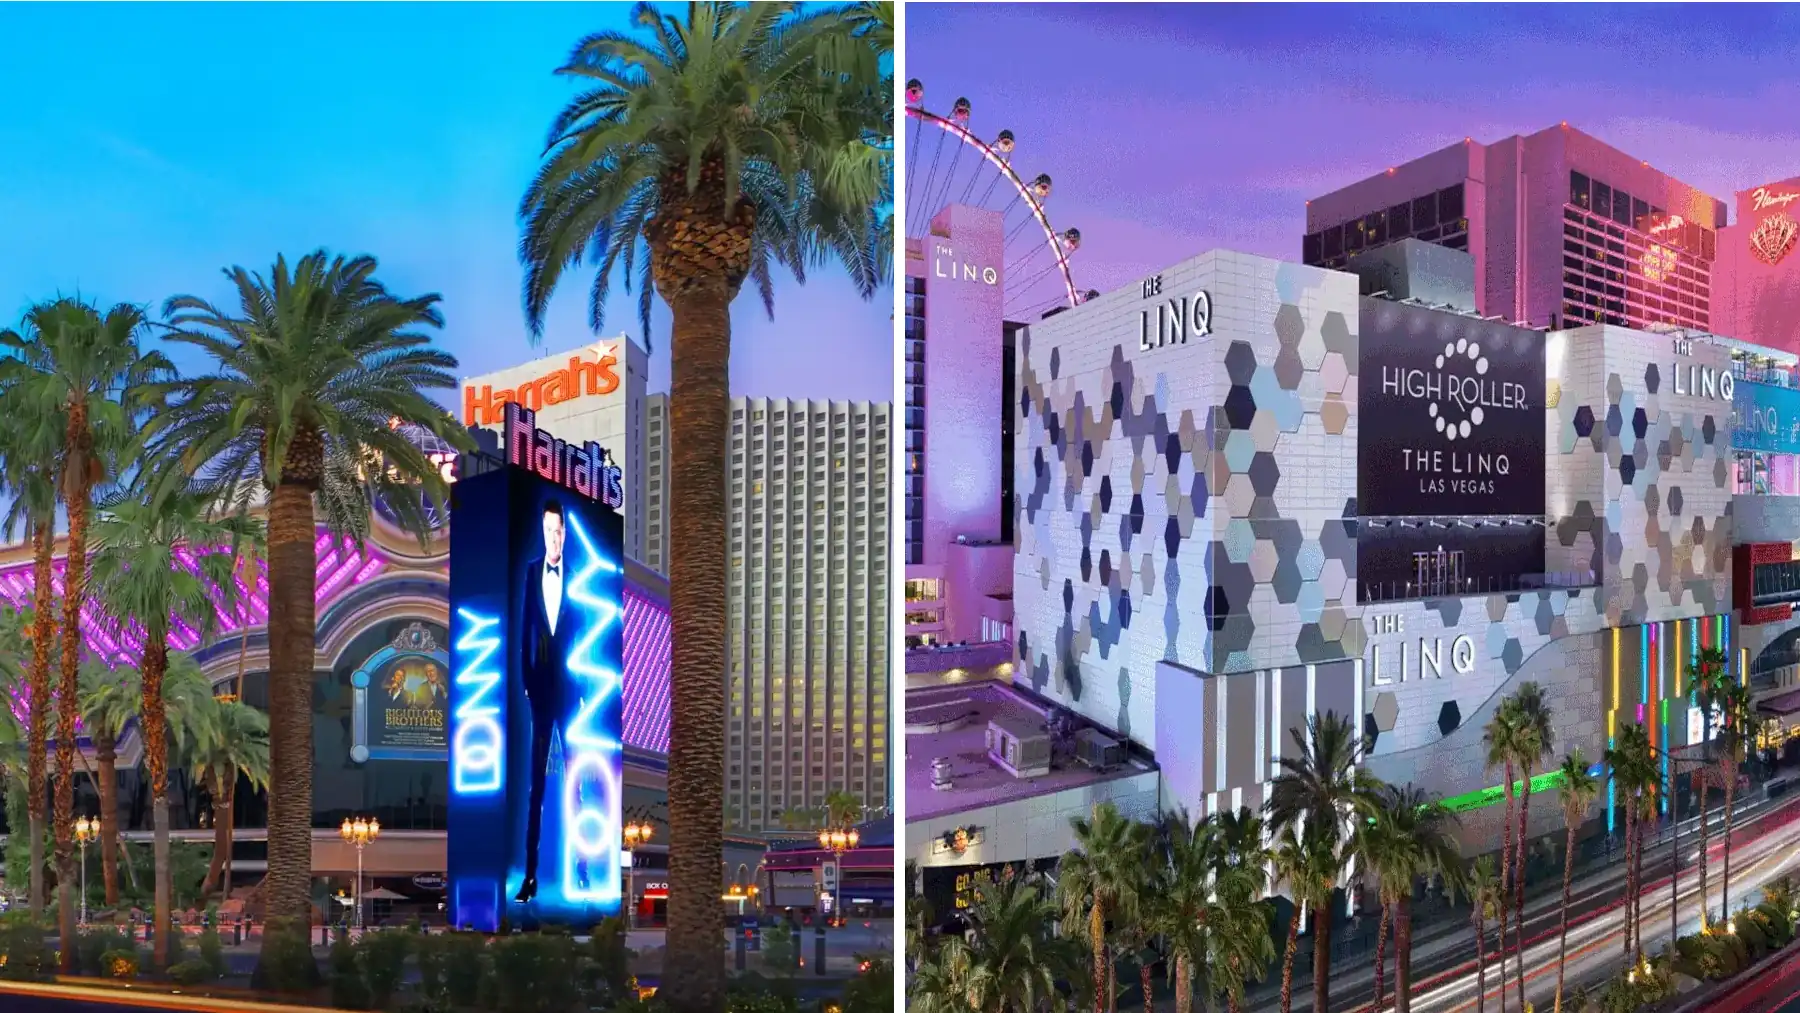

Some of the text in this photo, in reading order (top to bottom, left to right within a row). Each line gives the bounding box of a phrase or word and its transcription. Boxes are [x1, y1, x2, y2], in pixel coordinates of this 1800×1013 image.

[936, 245, 953, 256] THE
[936, 258, 997, 285] LINQ
[1140, 274, 1162, 299] THE
[1140, 290, 1212, 351] LINQ
[1674, 339, 1693, 356] THE
[1383, 365, 1442, 400] HIGH
[1674, 363, 1734, 400] LINQ
[1402, 449, 1510, 475] THE LINQ
[1420, 478, 1495, 494] LAS VEGAS
[1373, 614, 1405, 634] THE
[1372, 634, 1475, 686] LINQ
